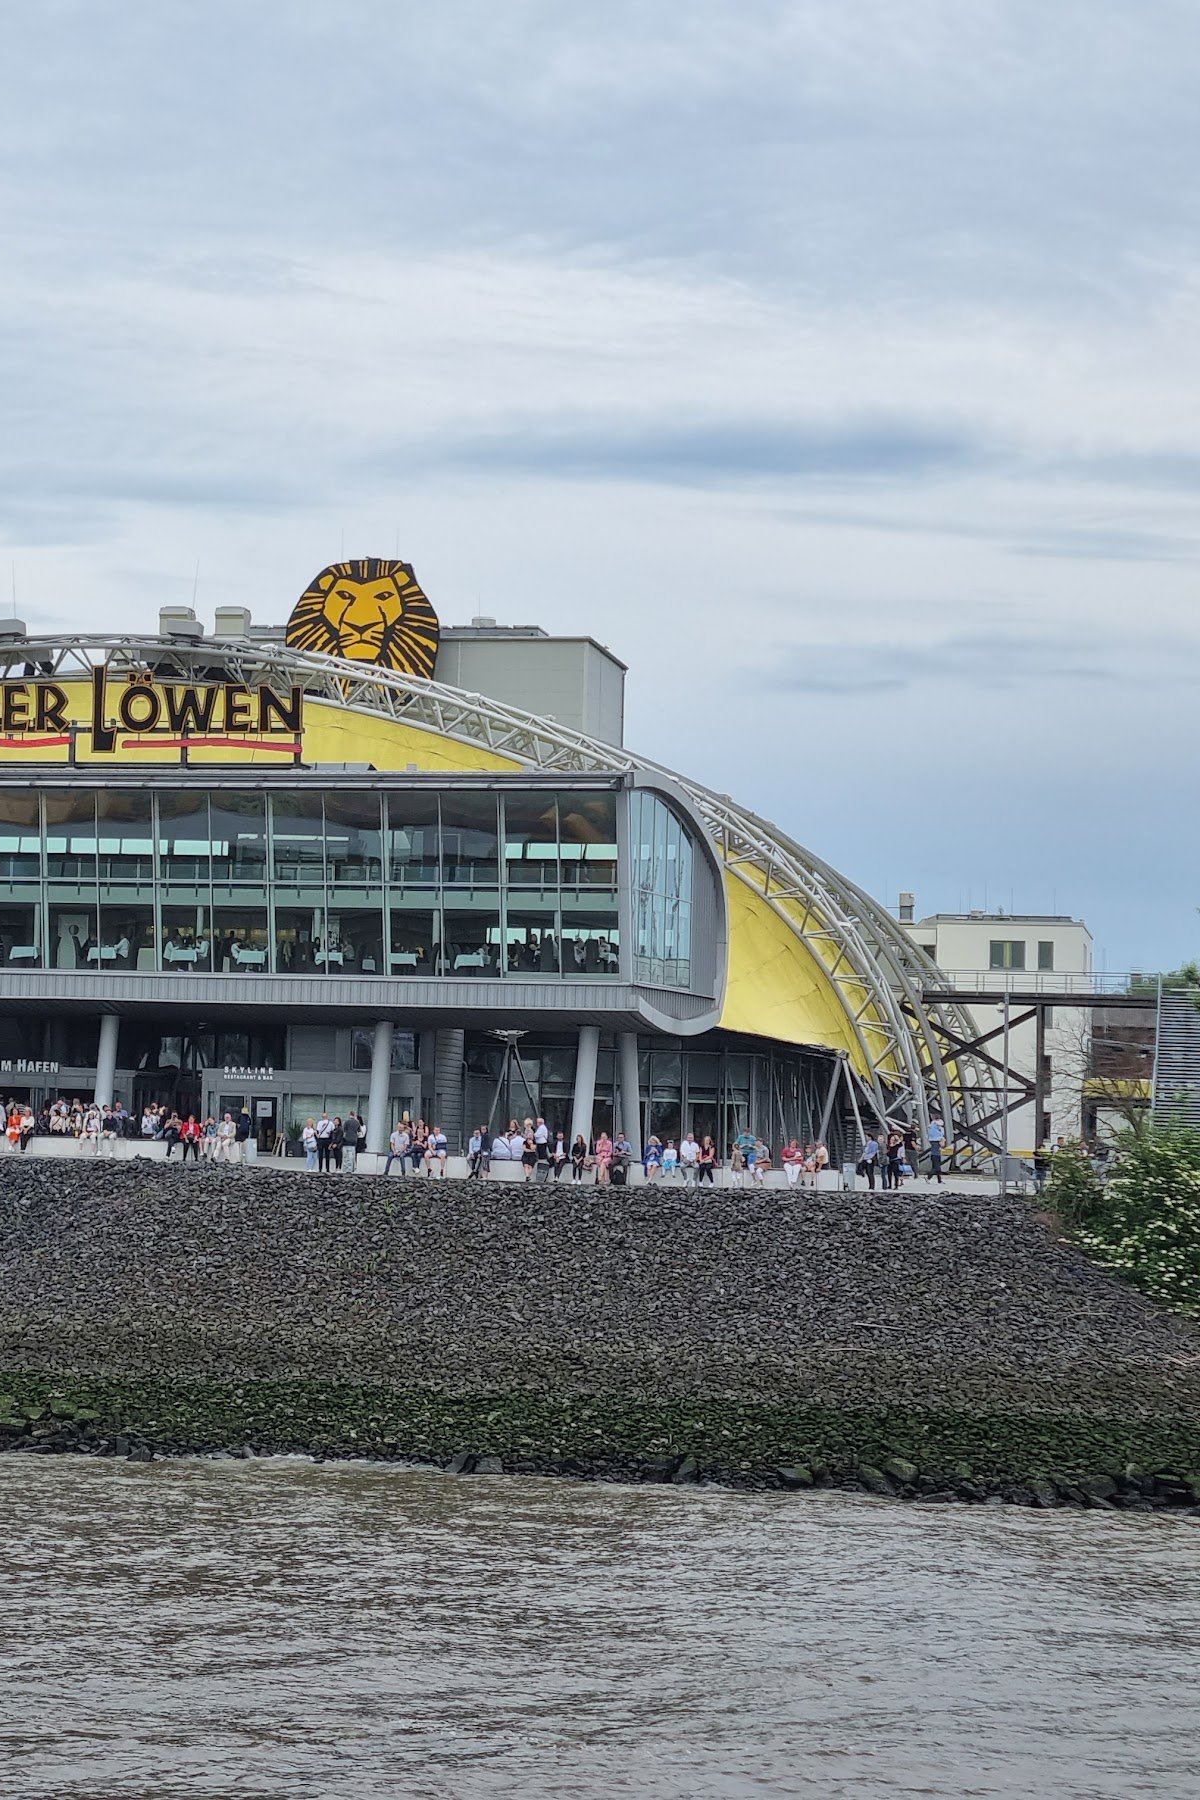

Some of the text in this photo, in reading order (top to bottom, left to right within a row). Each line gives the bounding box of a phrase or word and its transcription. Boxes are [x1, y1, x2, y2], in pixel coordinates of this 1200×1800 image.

[91, 664, 305, 753] LÖWEN
[17, 1059, 59, 1074] HAFEN
[224, 1066, 274, 1075] SKYLINE
